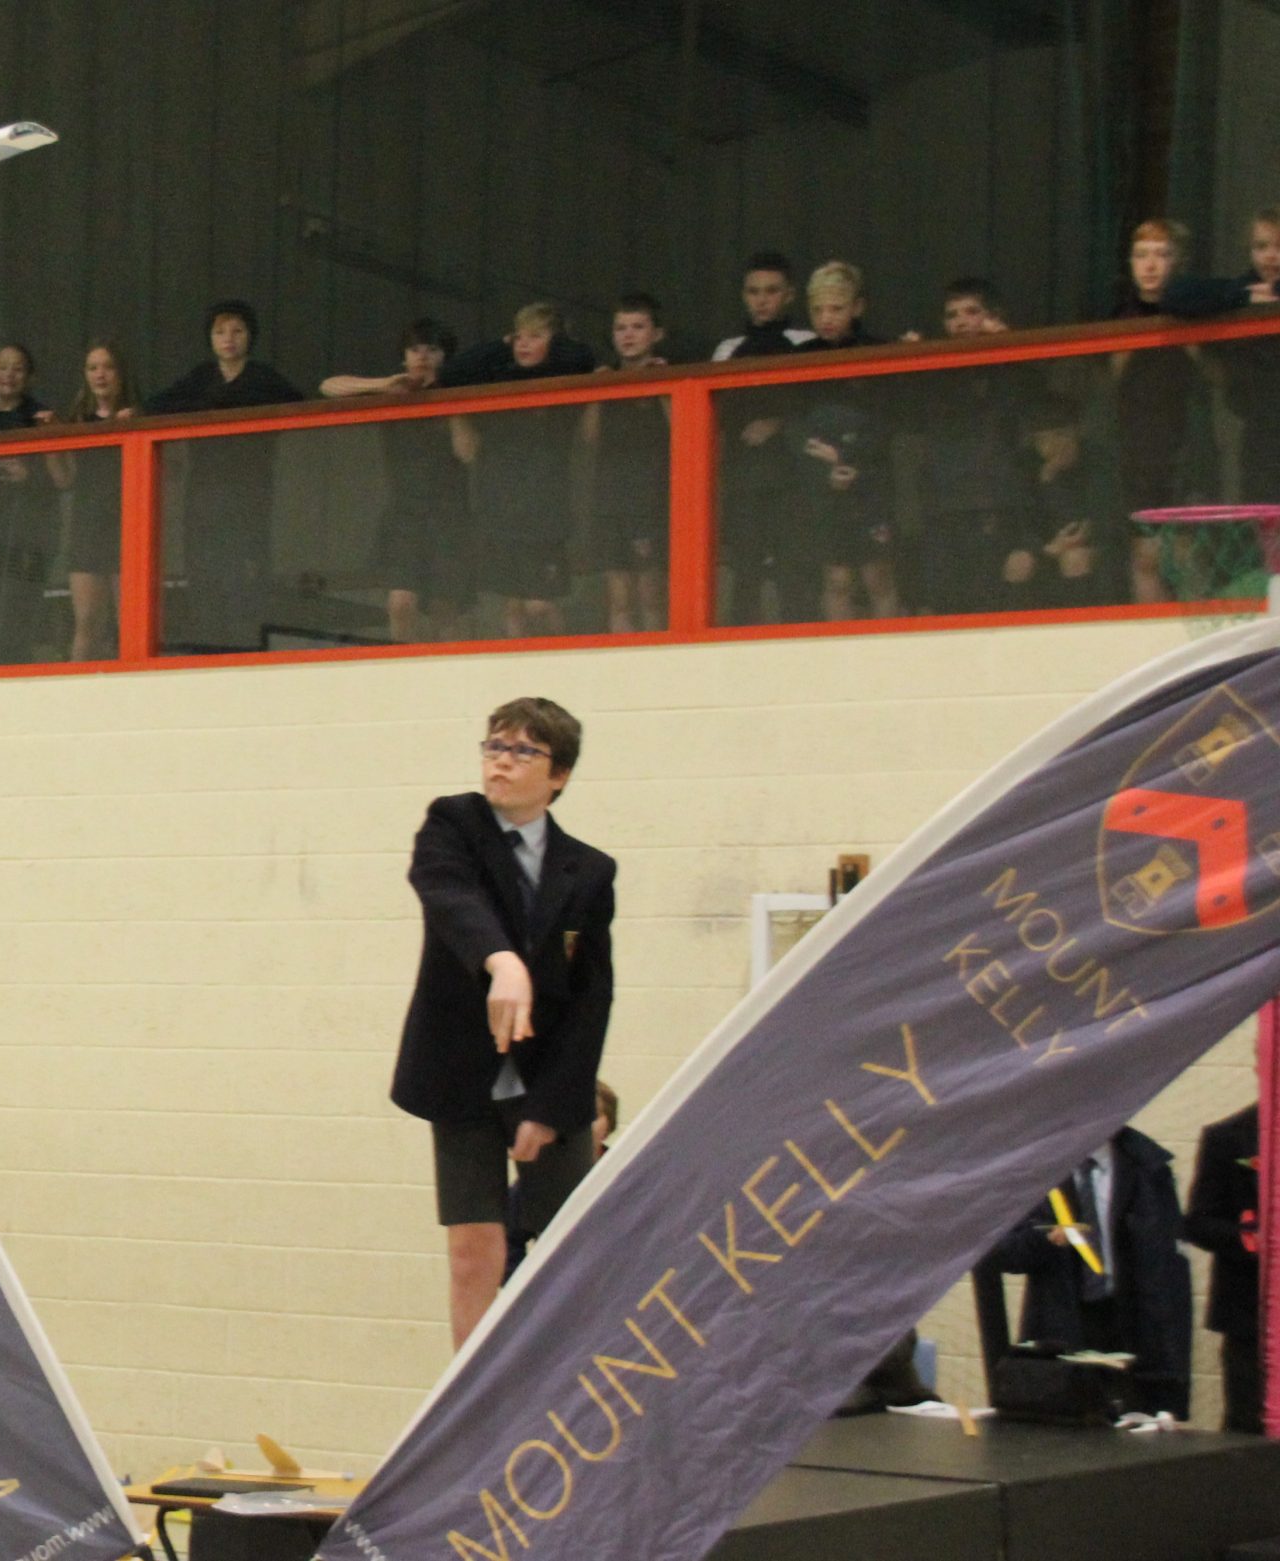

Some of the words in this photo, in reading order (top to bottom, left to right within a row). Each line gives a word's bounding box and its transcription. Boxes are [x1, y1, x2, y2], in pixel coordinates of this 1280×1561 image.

[942, 932, 1076, 1066] KELLY
[981, 867, 1148, 1035] MOUNT
[447, 1268, 707, 1561] MOUNT
[698, 1023, 937, 1294] KELLY
